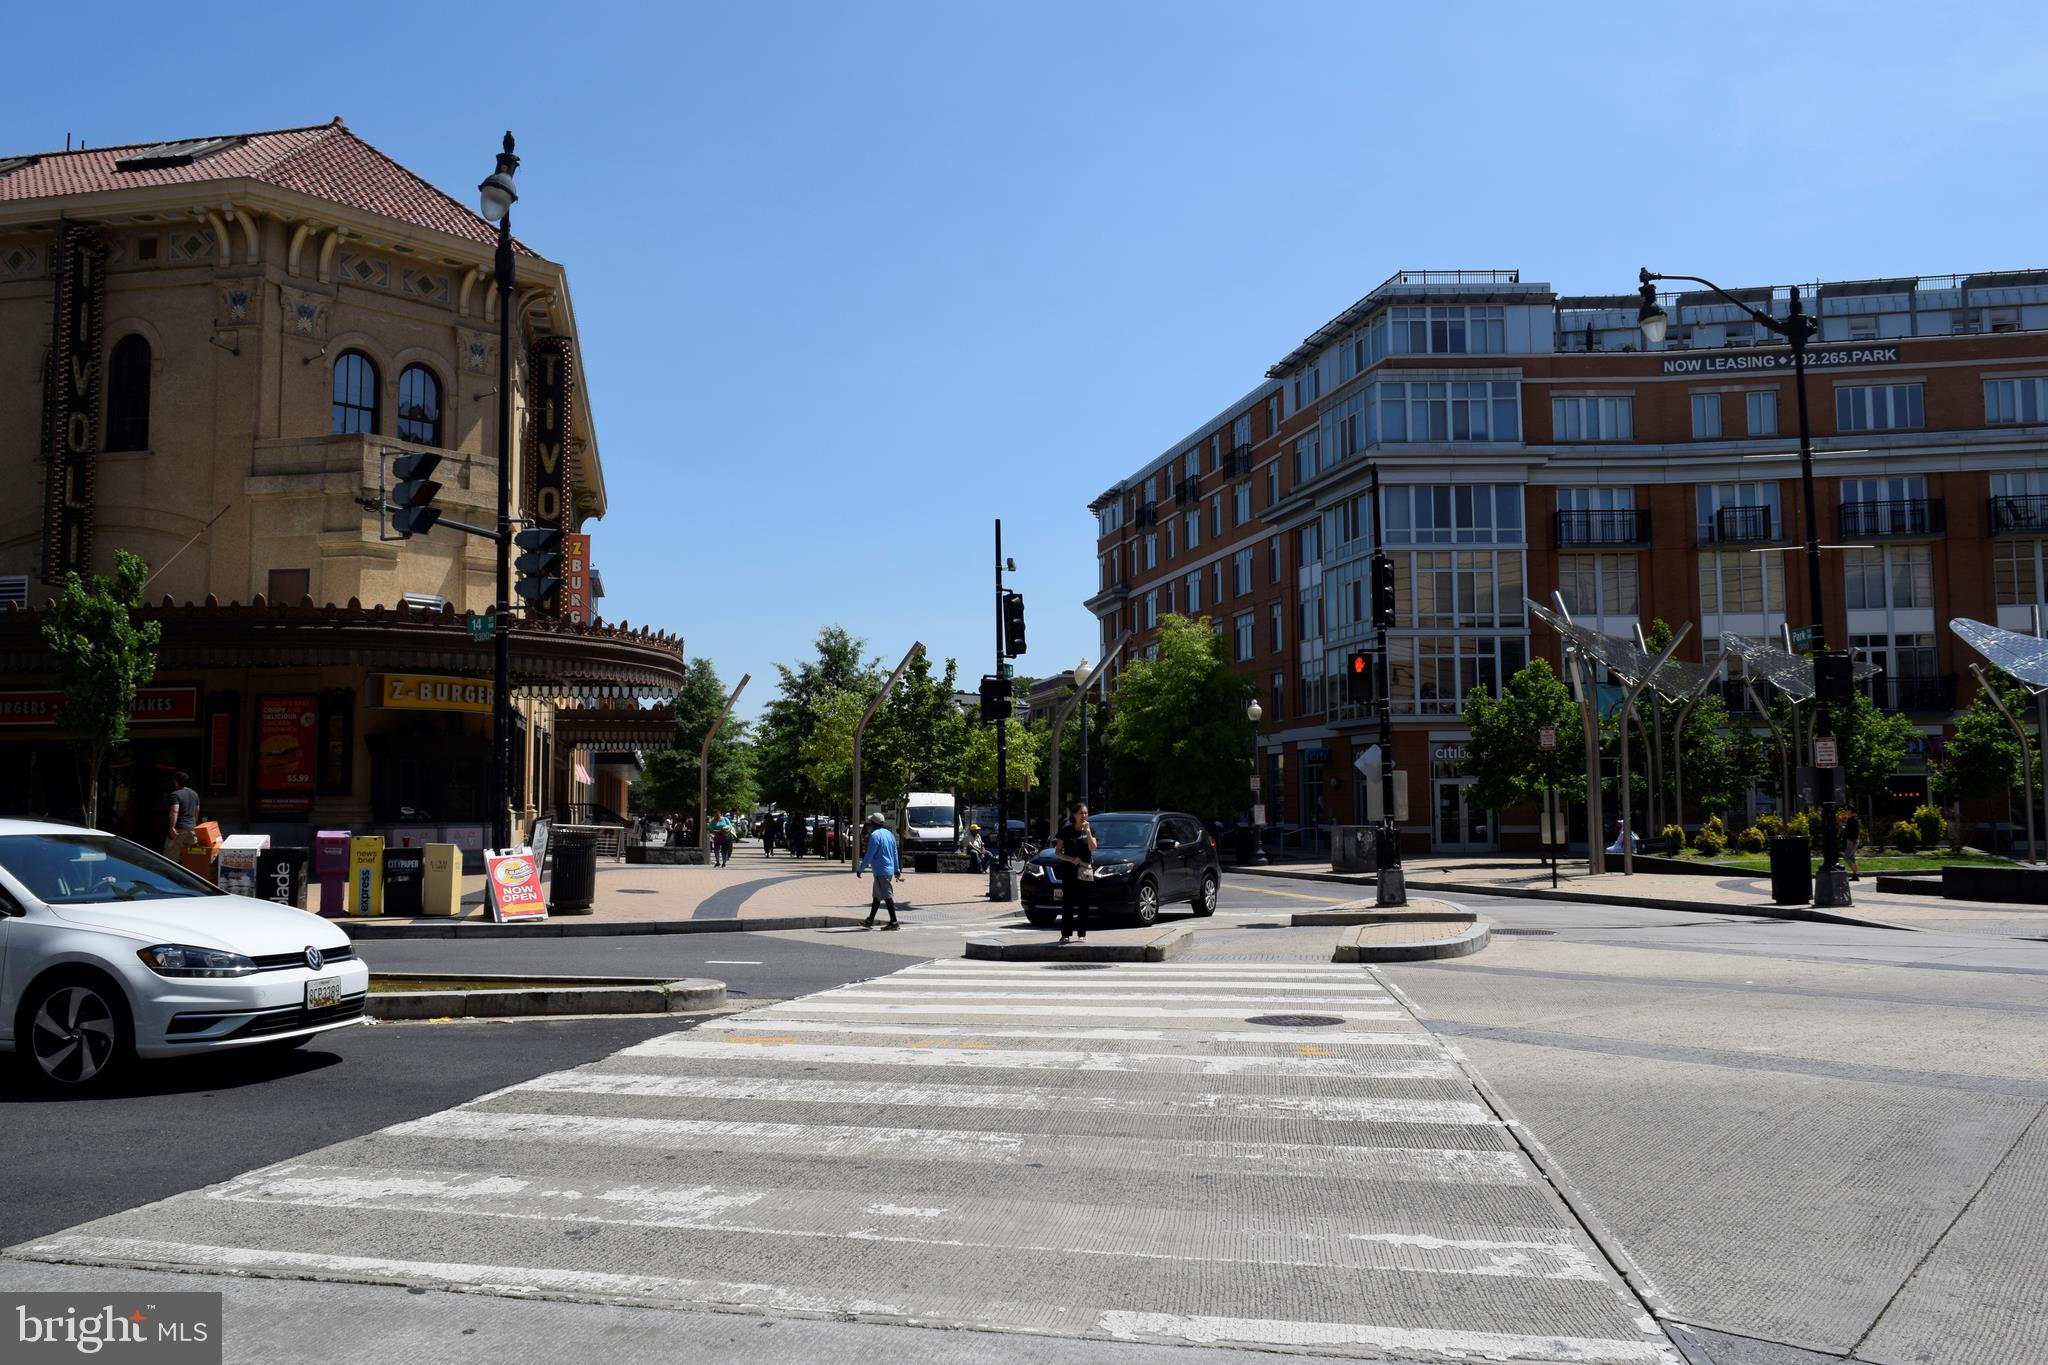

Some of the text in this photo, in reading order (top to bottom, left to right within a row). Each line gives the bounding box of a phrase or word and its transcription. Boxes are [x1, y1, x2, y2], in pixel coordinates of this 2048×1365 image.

[1664, 360, 1701, 373] NOW
[1706, 355, 1775, 371] LEASING
[64, 244, 97, 565] TIVOLI
[472, 618, 482, 631] 14
[1792, 630, 1806, 643] Park
[128, 697, 173, 711] HAKES
[360, 870, 370, 912] express
[503, 885, 533, 895] NOW
[502, 892, 537, 903] OPEN
